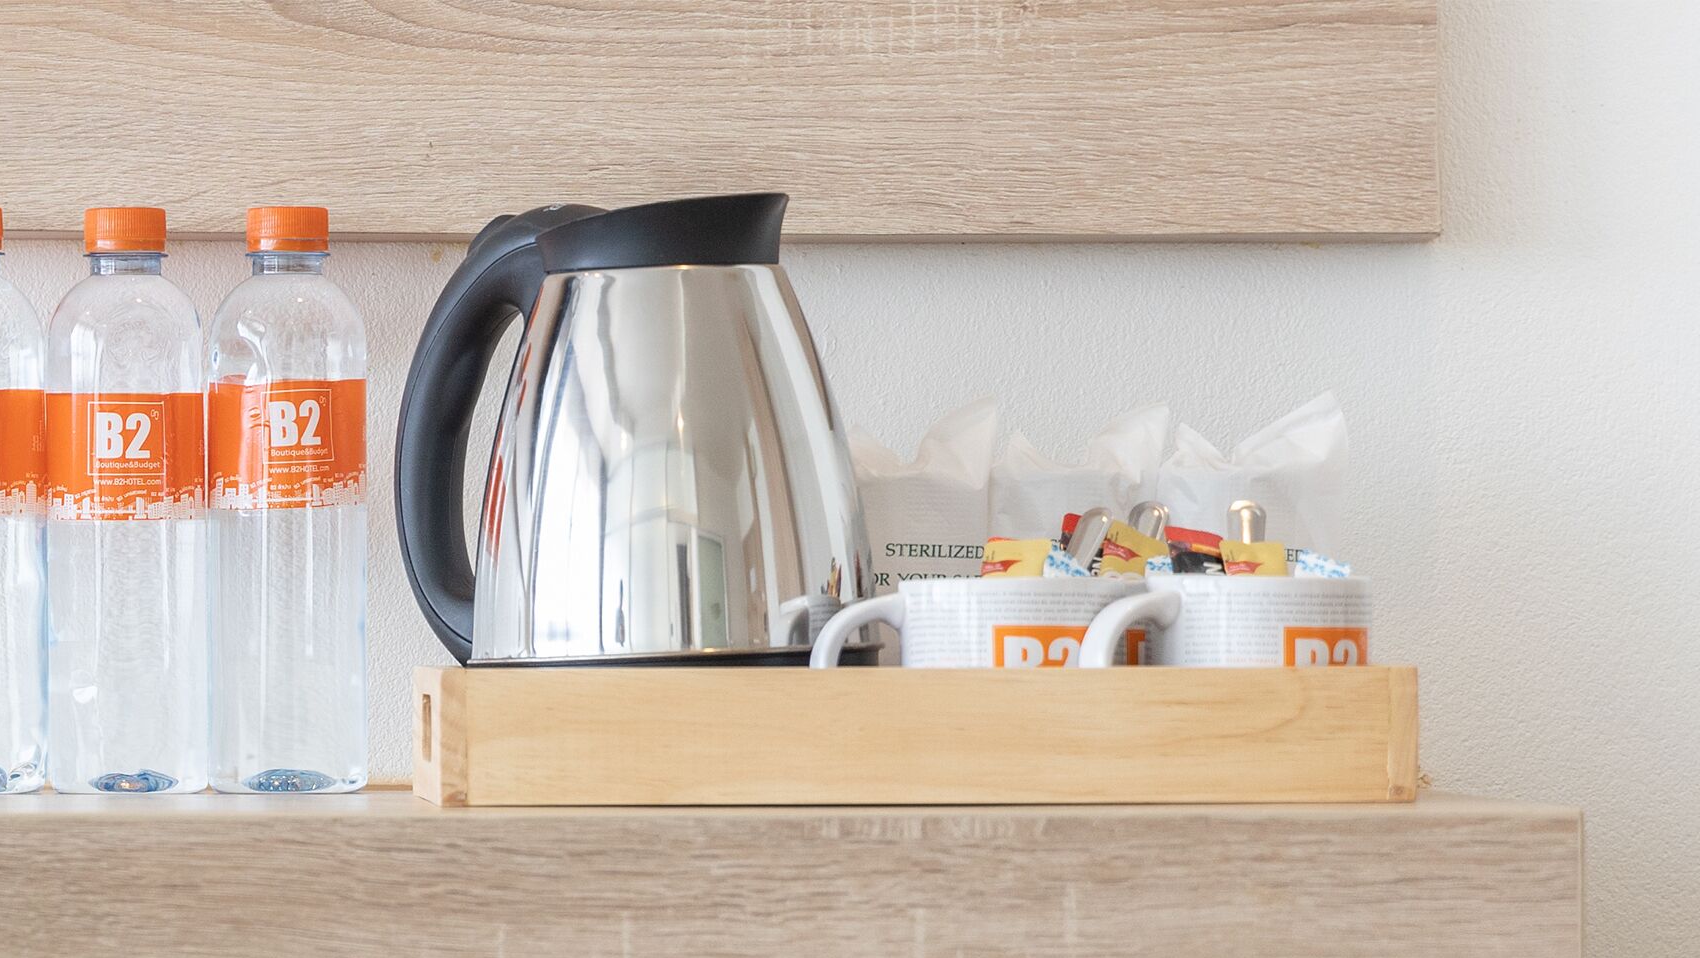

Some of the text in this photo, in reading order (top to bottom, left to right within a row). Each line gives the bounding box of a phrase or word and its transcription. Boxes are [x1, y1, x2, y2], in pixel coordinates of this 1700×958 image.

[268, 399, 322, 447] B2
[95, 412, 151, 459] B2
[96, 460, 160, 470] Boutique&Budget
[94, 477, 162, 486] www.B2HOTEL.com
[885, 542, 984, 560] STERILIZED
